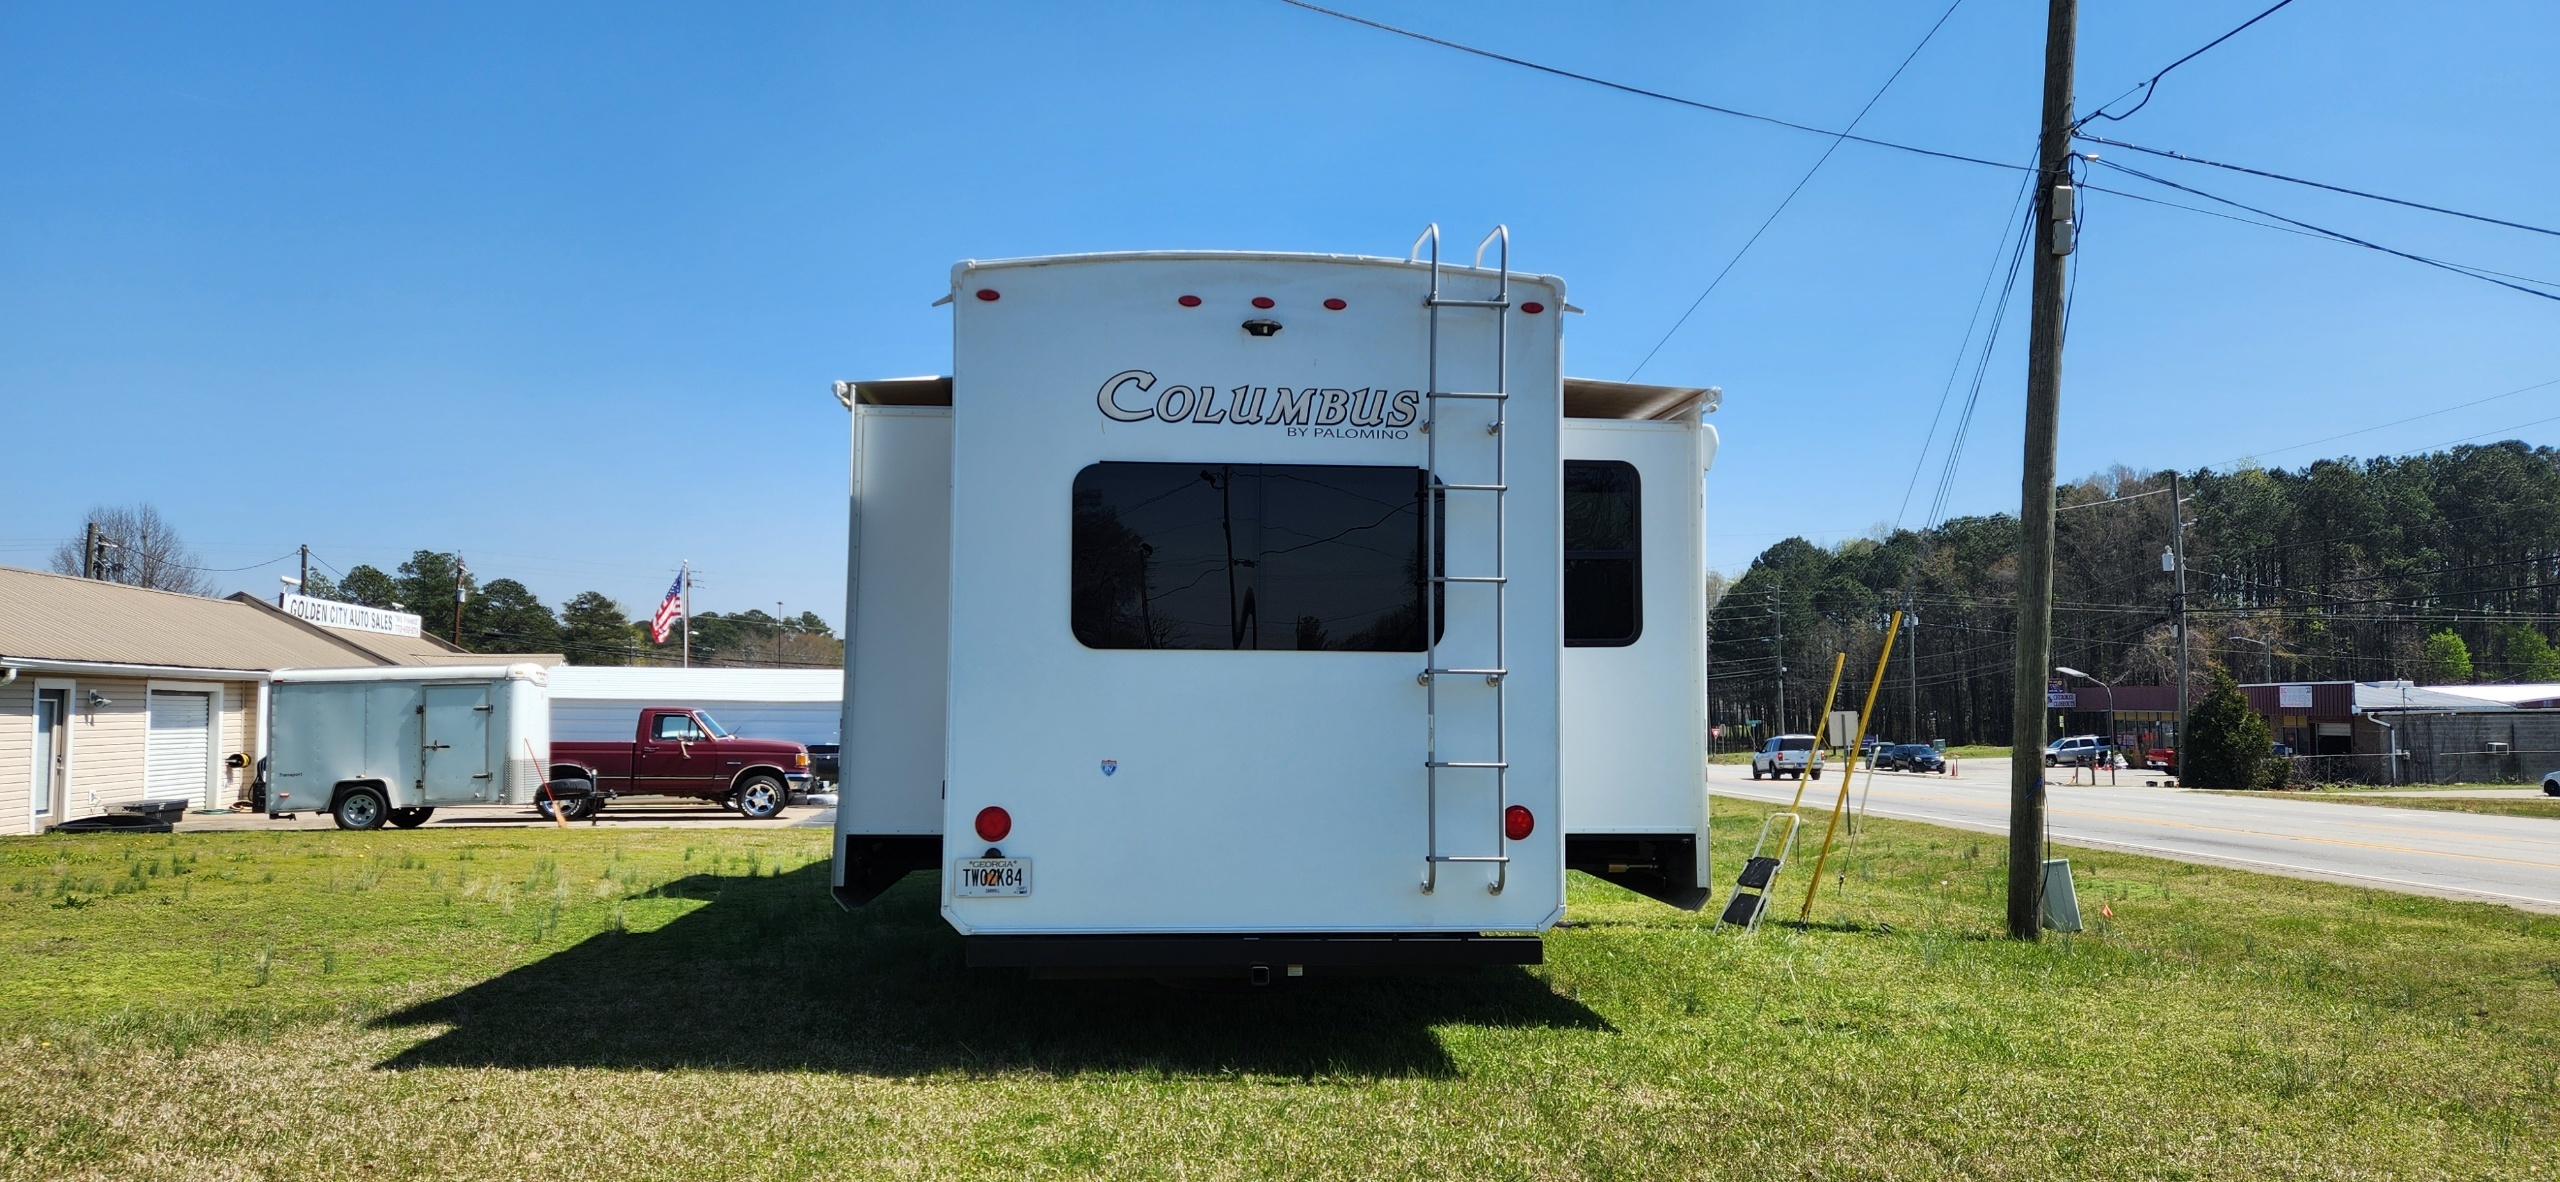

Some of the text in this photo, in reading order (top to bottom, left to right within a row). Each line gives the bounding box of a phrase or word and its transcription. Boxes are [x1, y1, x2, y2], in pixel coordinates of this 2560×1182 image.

[1097, 369, 1420, 428] COLUMBUS
[1287, 427, 1409, 440] BY PALOMINO
[290, 599, 393, 631] GOLDEN CITY AUTO SALES
